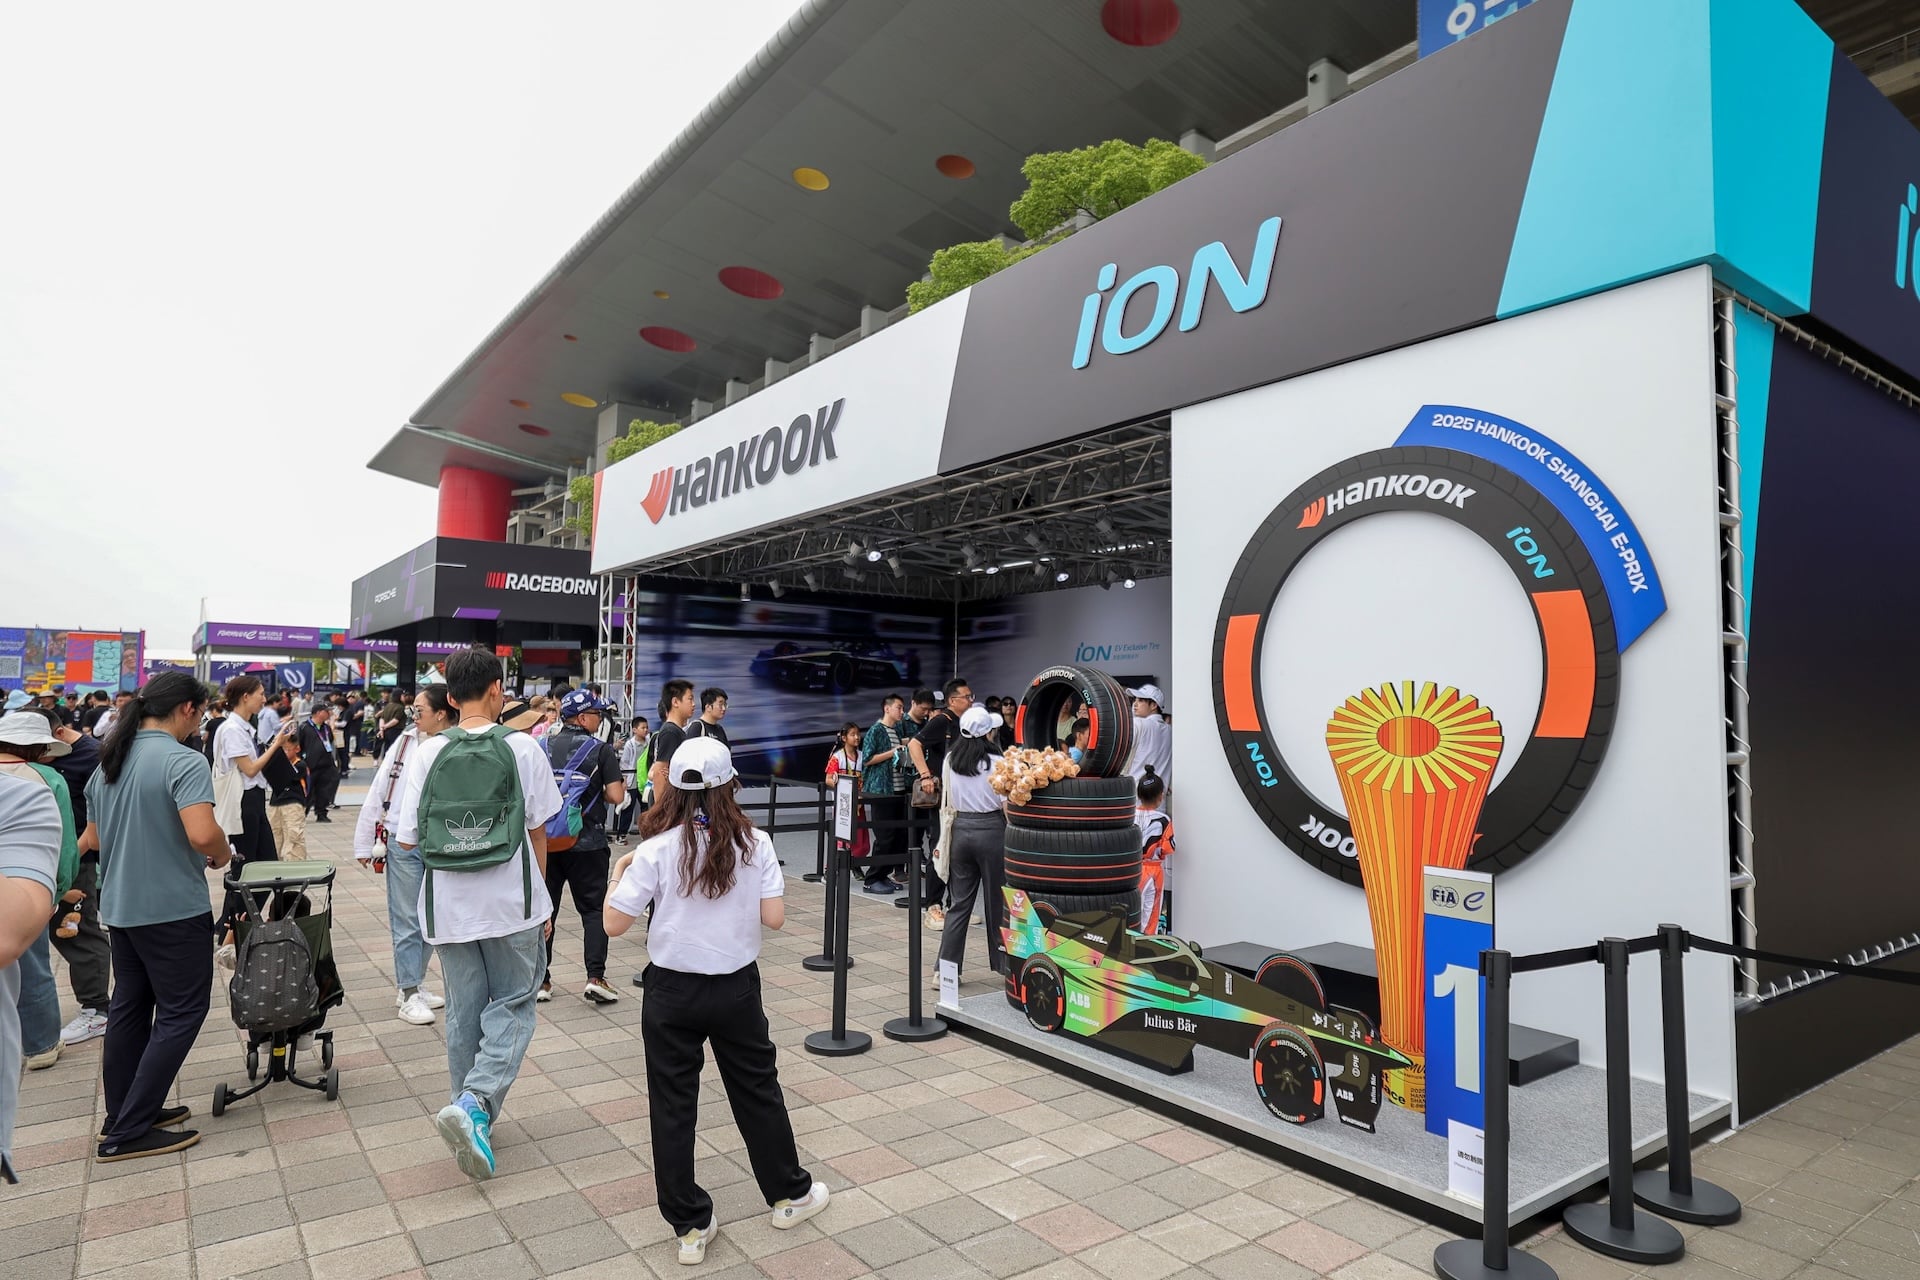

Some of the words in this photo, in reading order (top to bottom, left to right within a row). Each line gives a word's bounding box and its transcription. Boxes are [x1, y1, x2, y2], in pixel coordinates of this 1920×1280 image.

[1432, 414, 1475, 431] 2025
[1474, 420, 1551, 464] HANKOOK
[1546, 456, 1619, 532] SHANGHAI
[1610, 532, 1649, 594] E-PRIX
[505, 572, 598, 596] RACEBORN
[443, 840, 492, 853] adidas
[1300, 814, 1360, 860] OOK
[1069, 991, 1091, 1009] ABB
[1144, 1012, 1174, 1030] Julius
[1177, 1017, 1198, 1034] Bär
[1434, 963, 1481, 1094] 1
[1336, 1088, 1354, 1102] ABB
